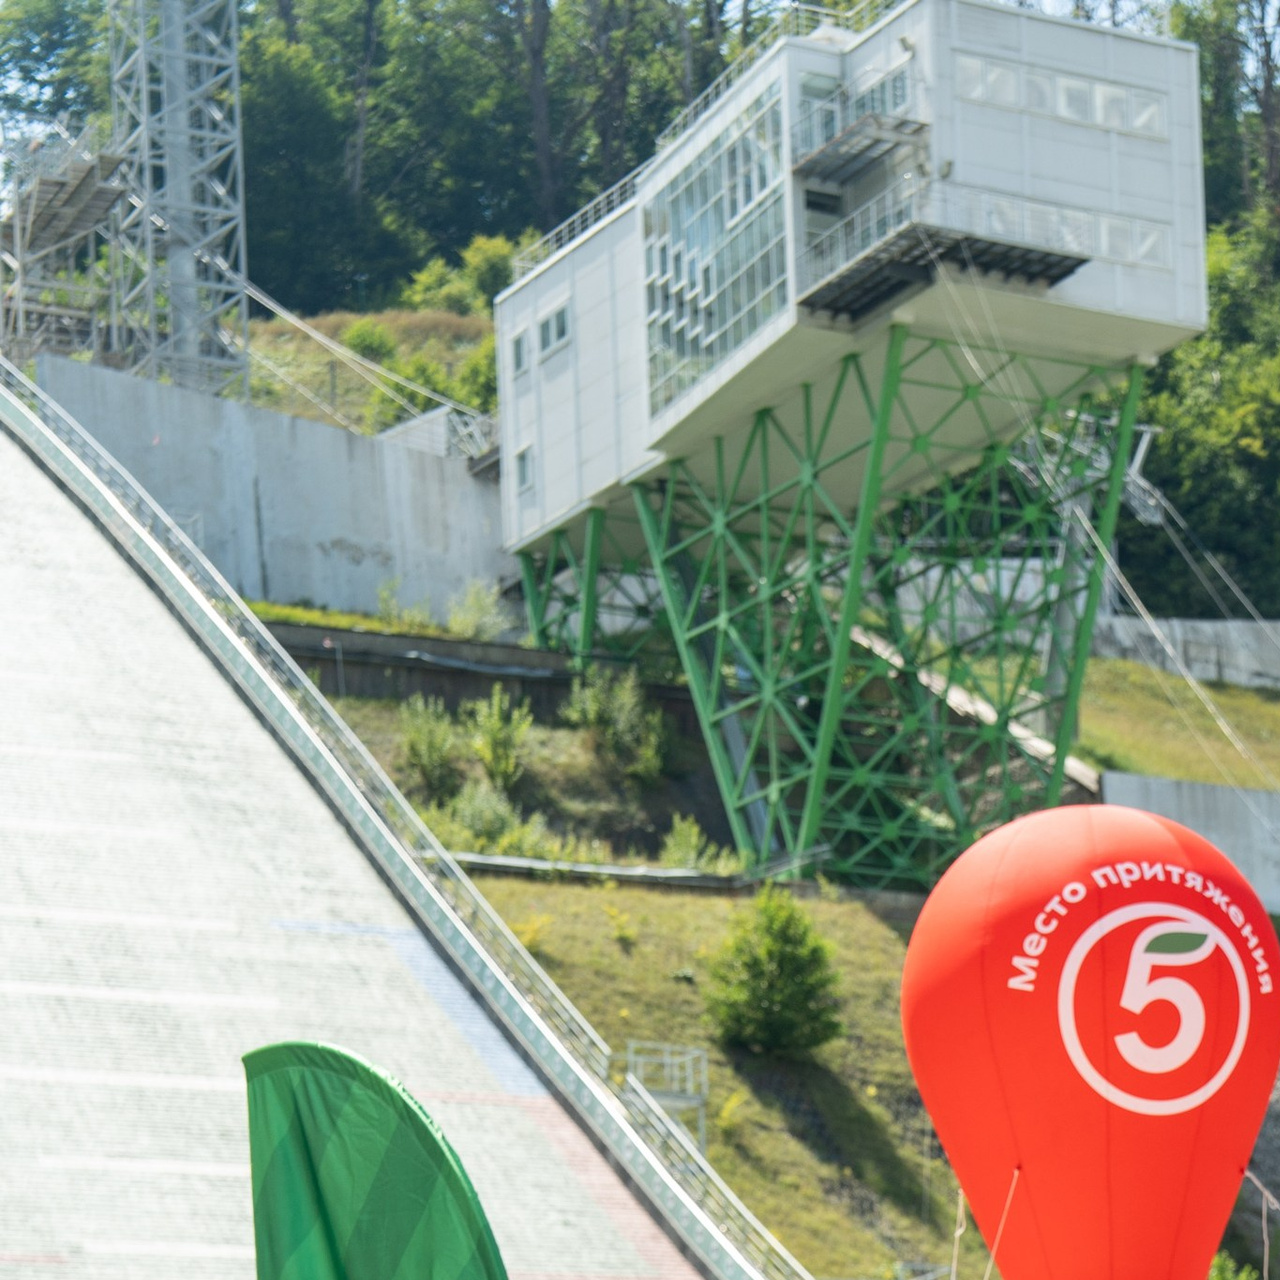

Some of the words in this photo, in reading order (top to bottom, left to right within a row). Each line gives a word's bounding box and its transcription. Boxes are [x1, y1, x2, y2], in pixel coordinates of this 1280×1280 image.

[1007, 881, 1087, 992] Место
[1091, 861, 1274, 994] притяжения
[1114, 920, 1218, 1074] 5
